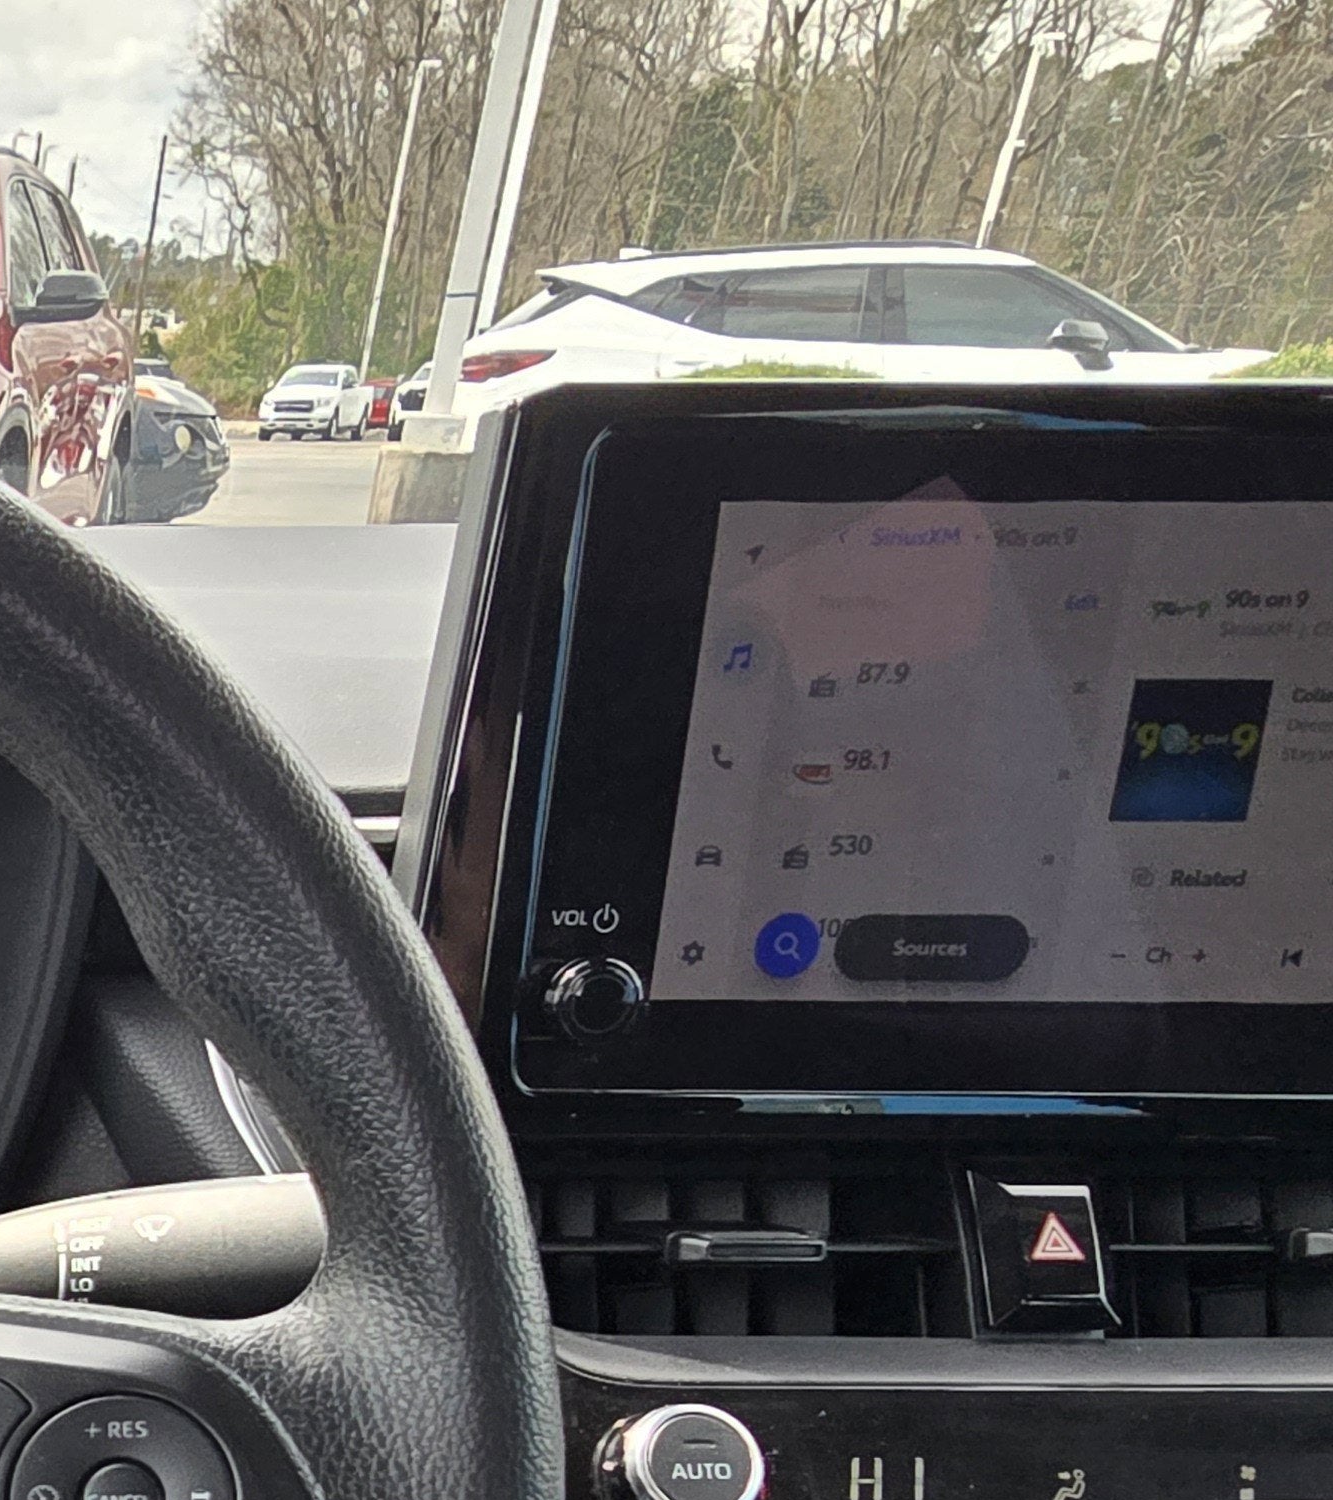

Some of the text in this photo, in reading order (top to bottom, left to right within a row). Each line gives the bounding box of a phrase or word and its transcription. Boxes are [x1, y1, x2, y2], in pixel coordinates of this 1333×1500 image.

[1296, 588, 1311, 609] 9
[856, 662, 910, 685] 87.9
[1231, 721, 1260, 760] 9
[843, 749, 891, 771] 98.1
[829, 834, 873, 857] 530
[1170, 868, 1248, 888] Related
[551, 909, 588, 927] VOL
[891, 937, 969, 957] Sources
[69, 1277, 94, 1293] LO
[107, 1420, 150, 1439] RES
[672, 1463, 732, 1480] AUTO
